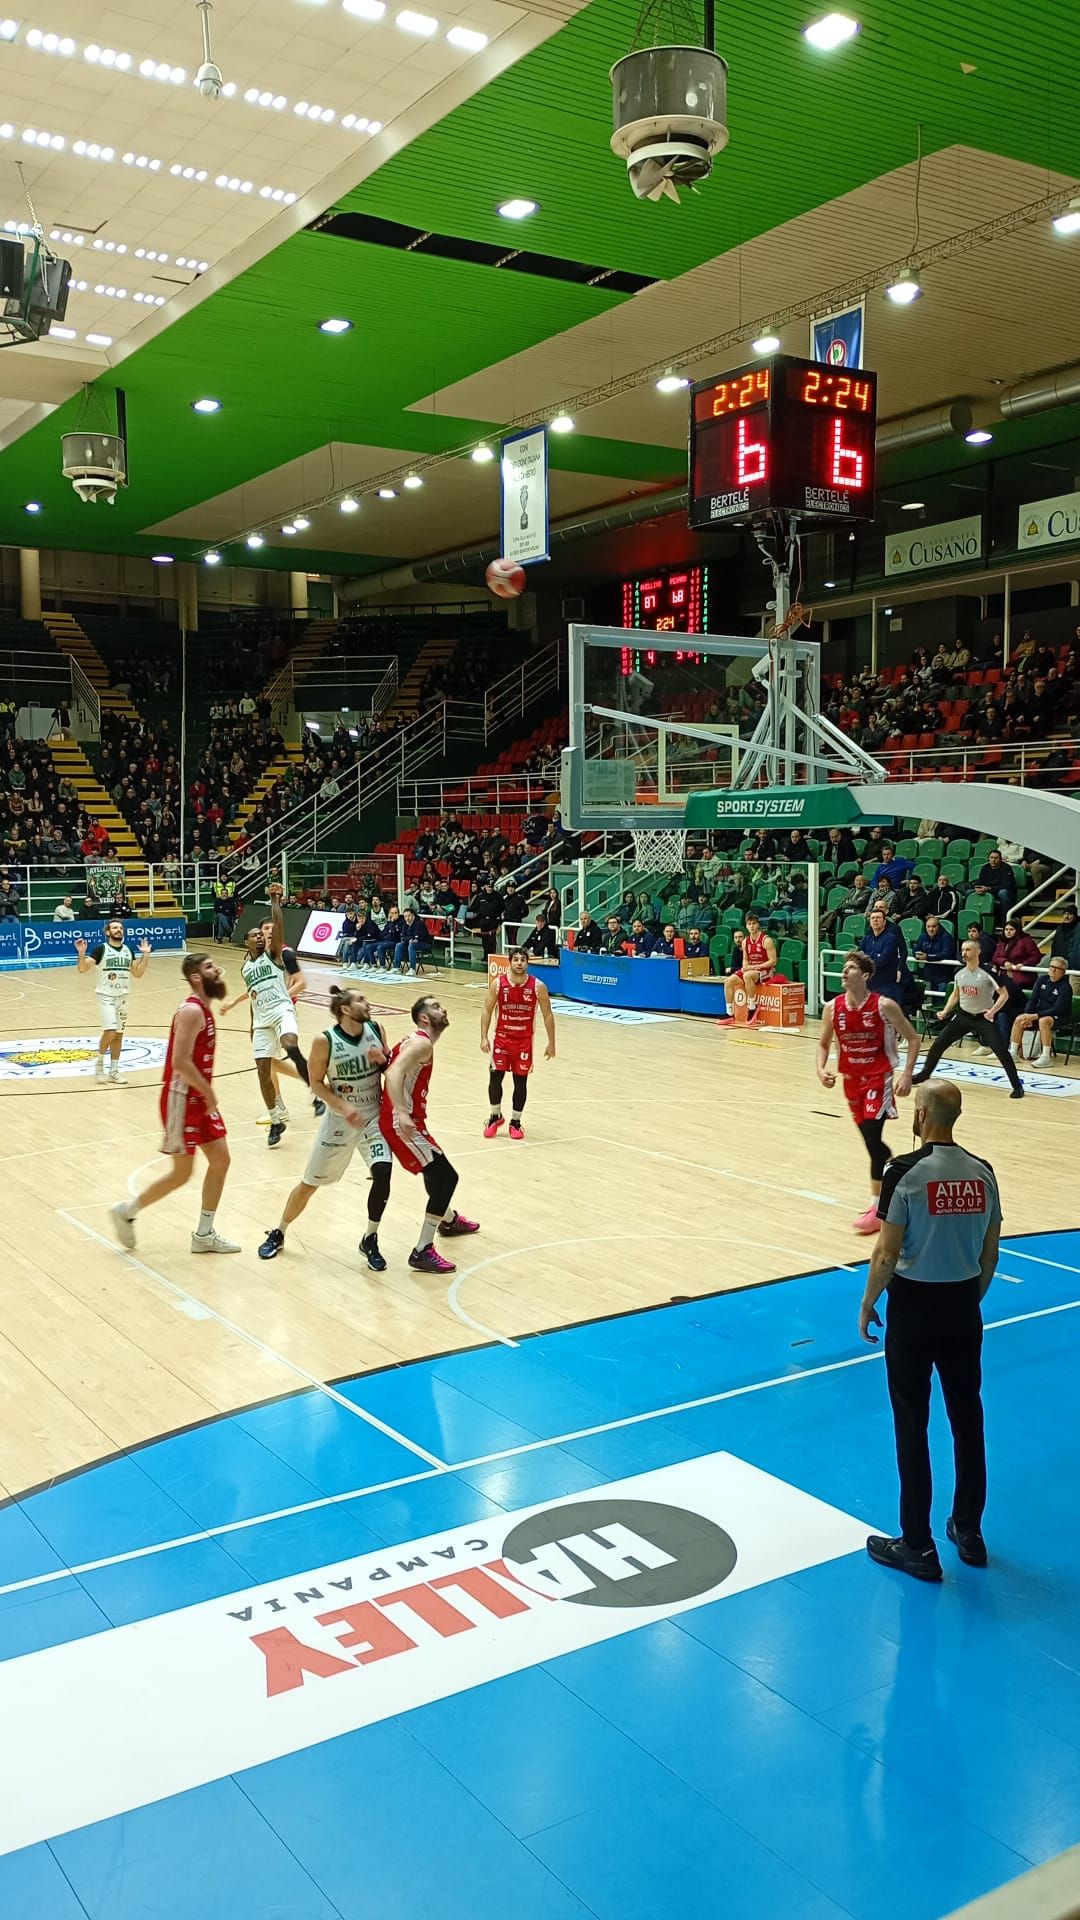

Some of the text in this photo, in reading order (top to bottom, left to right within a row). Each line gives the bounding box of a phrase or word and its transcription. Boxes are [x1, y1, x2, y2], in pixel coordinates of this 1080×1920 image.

[712, 369, 769, 416] 2:24
[804, 371, 869, 411] 2:24
[644, 595, 656, 609] 87
[656, 616, 674, 631] 2:24
[43, 930, 82, 939] BONO
[127, 927, 164, 936] BONO
[369, 1143, 384, 1158] 32
[935, 1181, 981, 1198] ATTAL
[935, 1197, 982, 1209] GROUP
[225, 1537, 489, 1622] CAMPANIA
[249, 1521, 678, 1698] HALLEY
